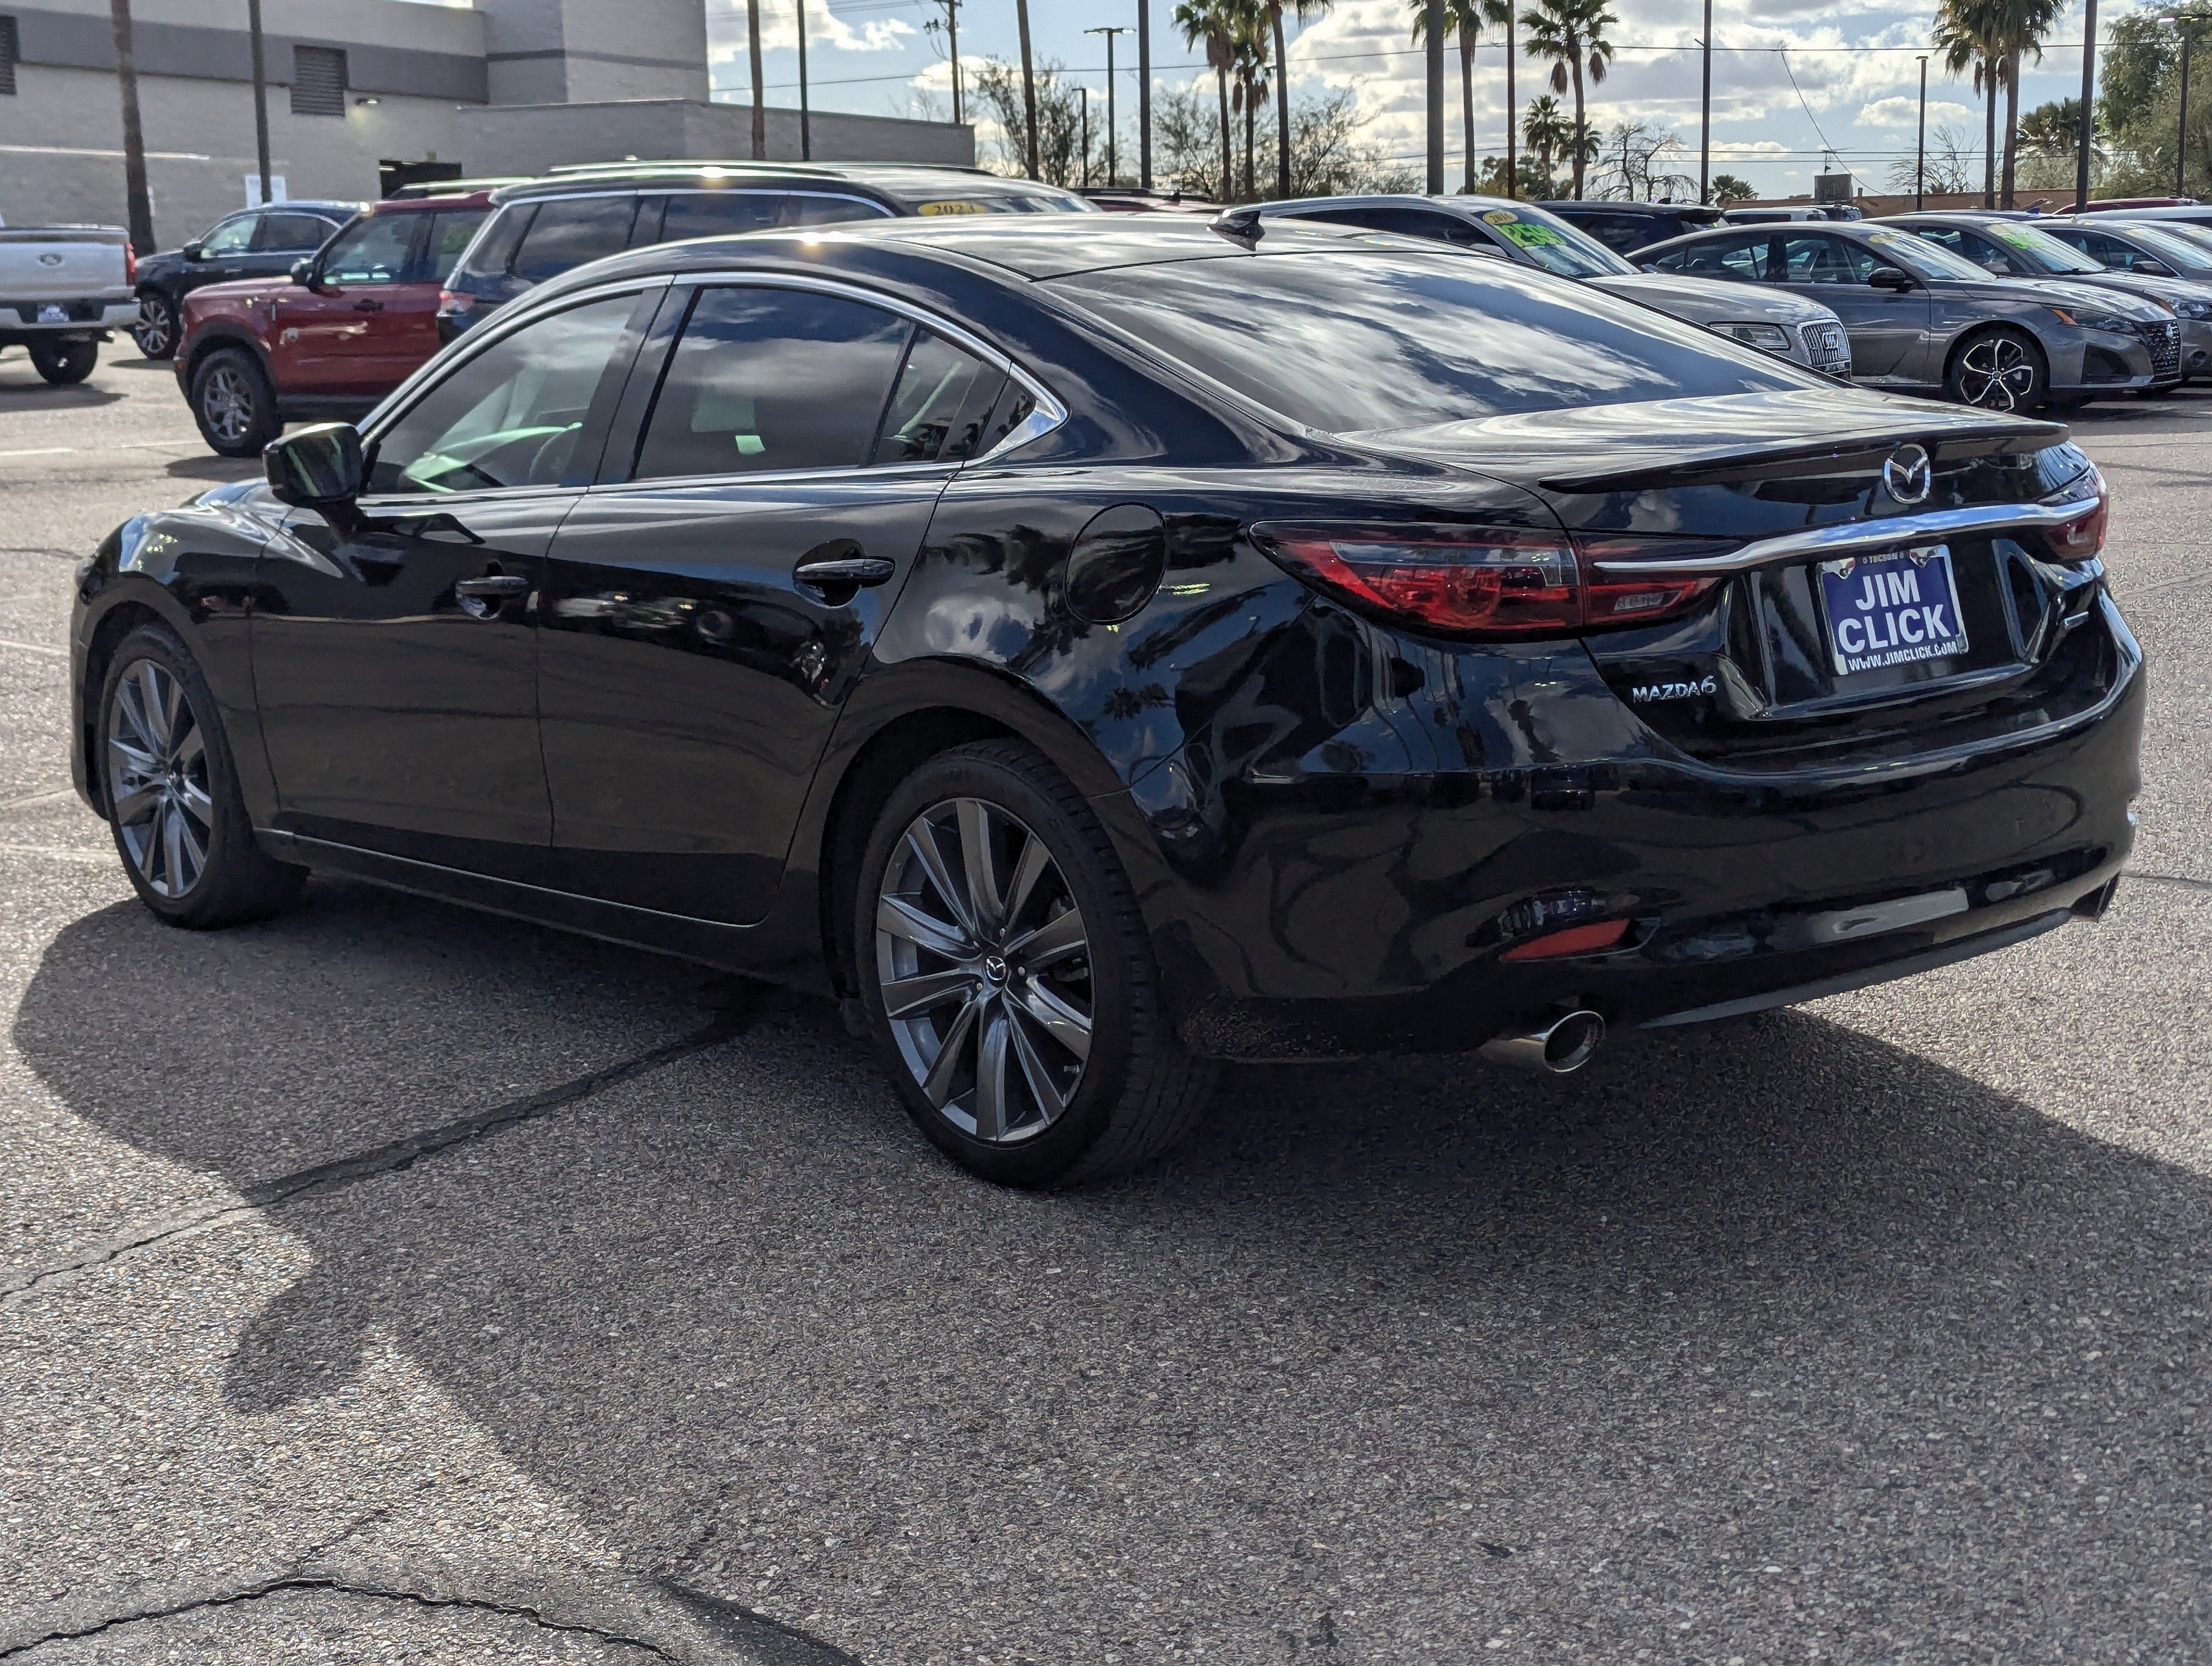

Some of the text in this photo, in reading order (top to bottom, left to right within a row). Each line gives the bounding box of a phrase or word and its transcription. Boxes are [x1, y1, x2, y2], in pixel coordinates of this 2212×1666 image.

[1855, 569, 1920, 610] JIM
[1838, 604, 1951, 653] CLICK
[1632, 675, 1717, 703] MAZDA6
